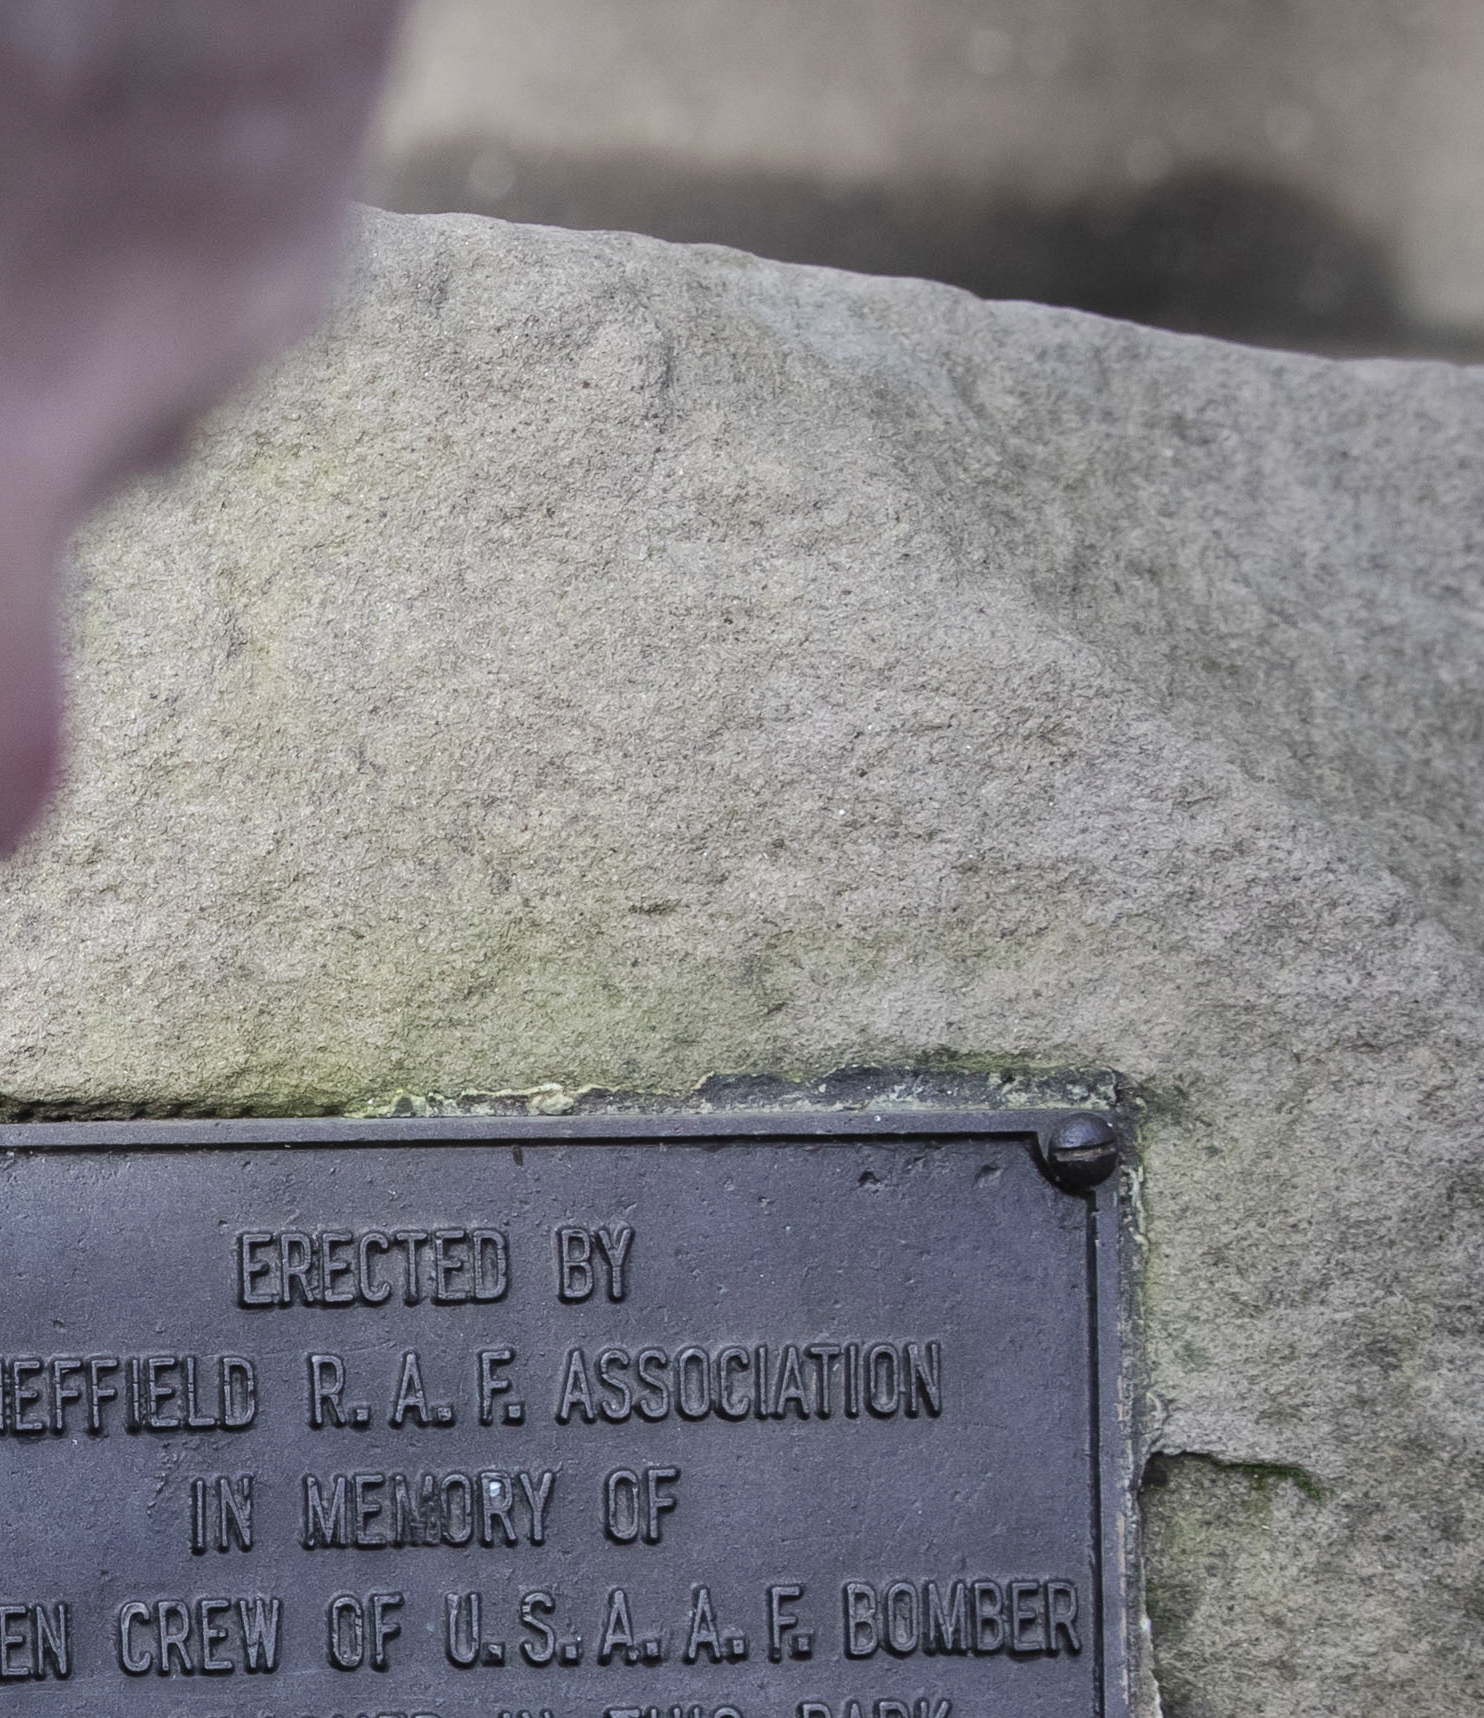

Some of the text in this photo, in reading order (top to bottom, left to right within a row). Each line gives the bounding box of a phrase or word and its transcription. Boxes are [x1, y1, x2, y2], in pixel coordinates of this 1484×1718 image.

[236, 1227, 634, 1307] ERECTED BY
[557, 1341, 942, 1424] ASSOCIATION
[189, 1466, 678, 1554] IN MEMORY OF
[119, 1596, 281, 1676] CREW
[328, 1595, 402, 1670] OF
[843, 1579, 1082, 1659] BOMBER
